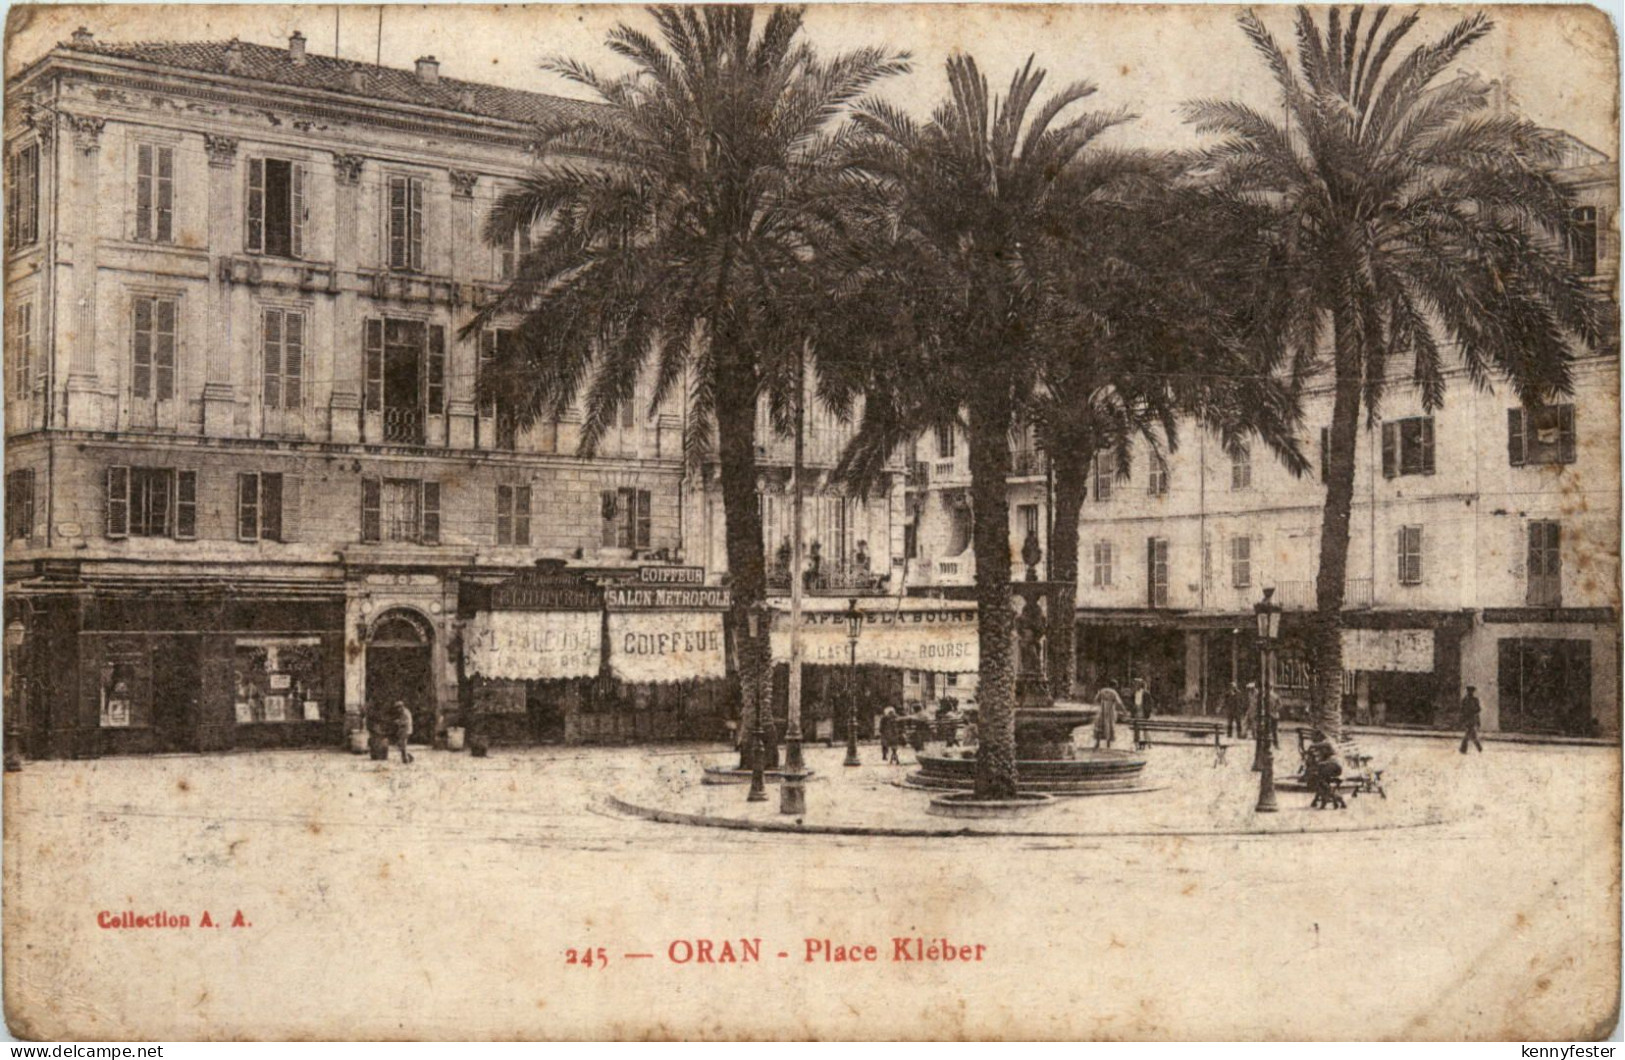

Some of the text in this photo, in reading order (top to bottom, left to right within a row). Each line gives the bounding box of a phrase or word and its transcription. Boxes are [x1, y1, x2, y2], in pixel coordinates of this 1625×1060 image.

[641, 567, 703, 583] COIFFEUR
[609, 590, 652, 606] SALON
[805, 610, 843, 625] AFE
[912, 608, 975, 623] BOURS
[623, 630, 719, 656] COIFFEUR
